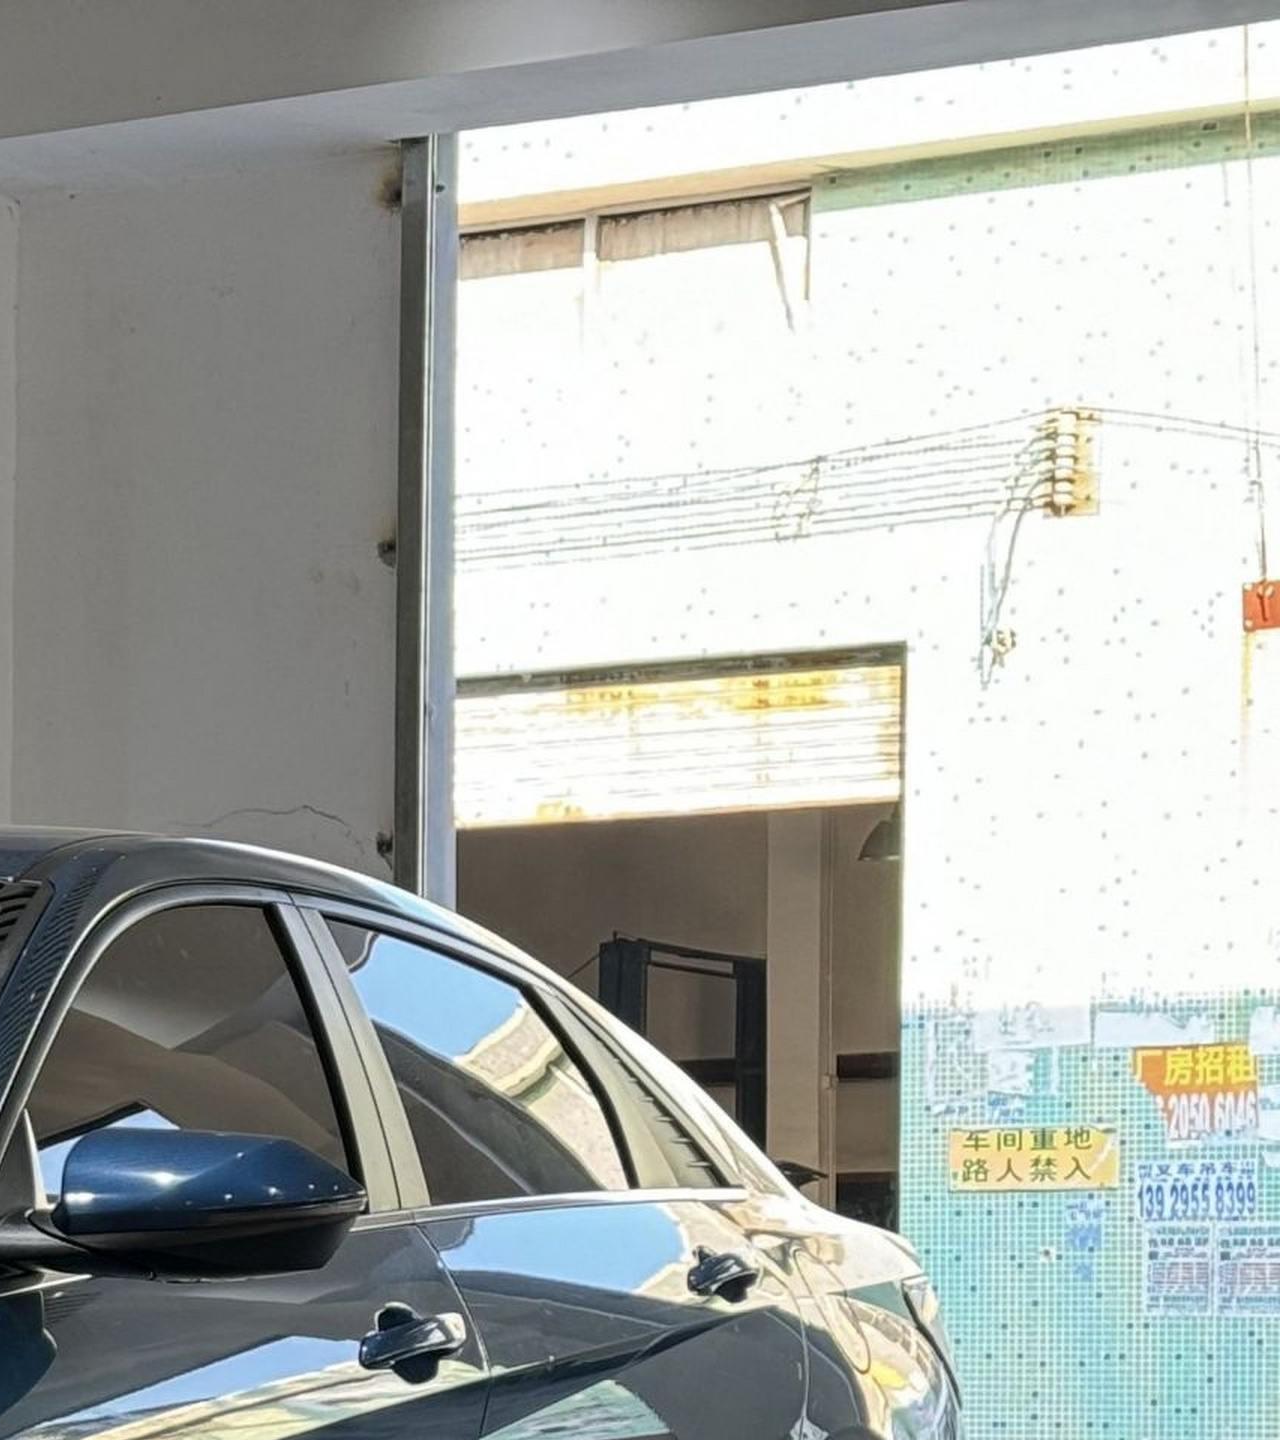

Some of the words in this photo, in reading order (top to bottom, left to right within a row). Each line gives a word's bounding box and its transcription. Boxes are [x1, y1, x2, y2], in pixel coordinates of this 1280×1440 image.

[963, 1126, 1092, 1151] 车间重地
[962, 1157, 1091, 1183] 路人禁入
[1138, 1182, 1165, 1219] 139
[1170, 1183, 1210, 1217] 2955
[1215, 1180, 1256, 1215] 8399
